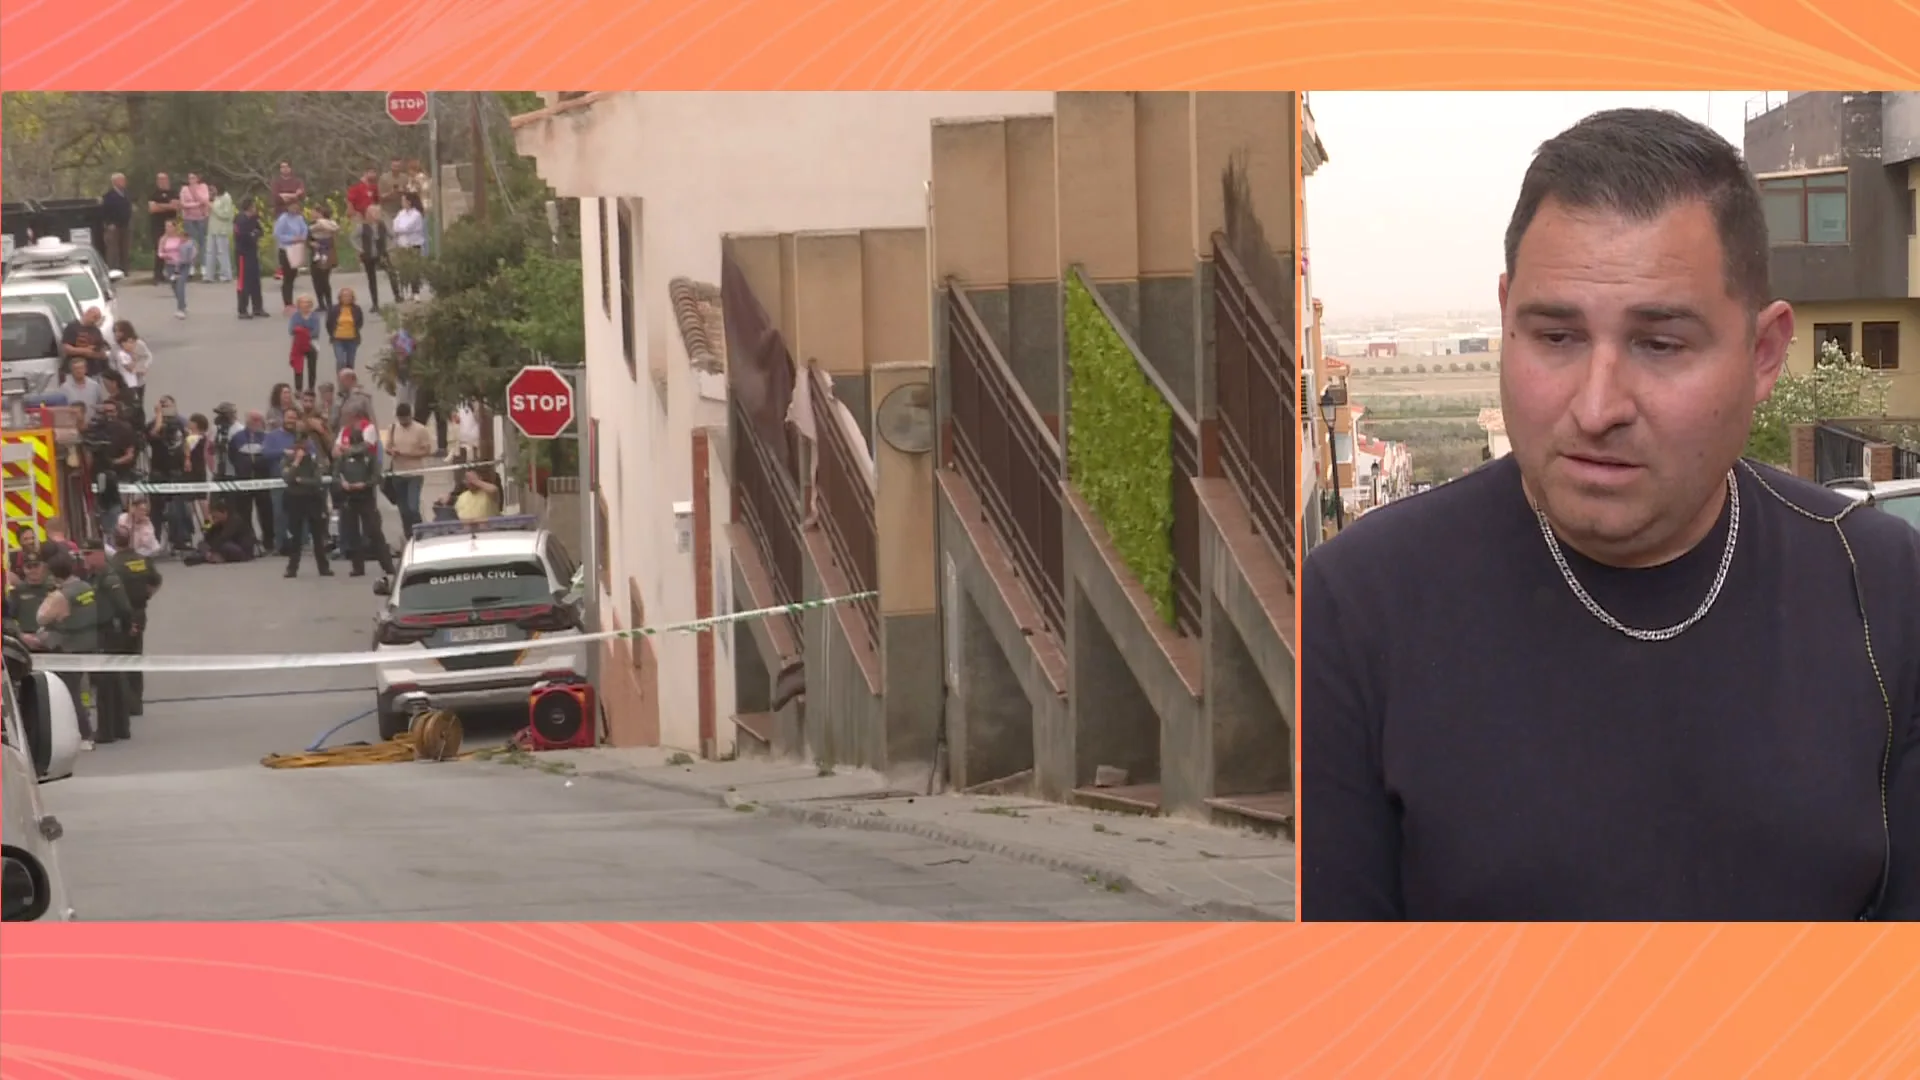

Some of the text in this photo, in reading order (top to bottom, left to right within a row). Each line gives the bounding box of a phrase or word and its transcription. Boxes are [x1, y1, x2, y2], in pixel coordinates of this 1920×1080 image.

[391, 98, 424, 110] STOP
[512, 394, 568, 412] STOP
[429, 570, 518, 585] GUARDIA CIVIL
